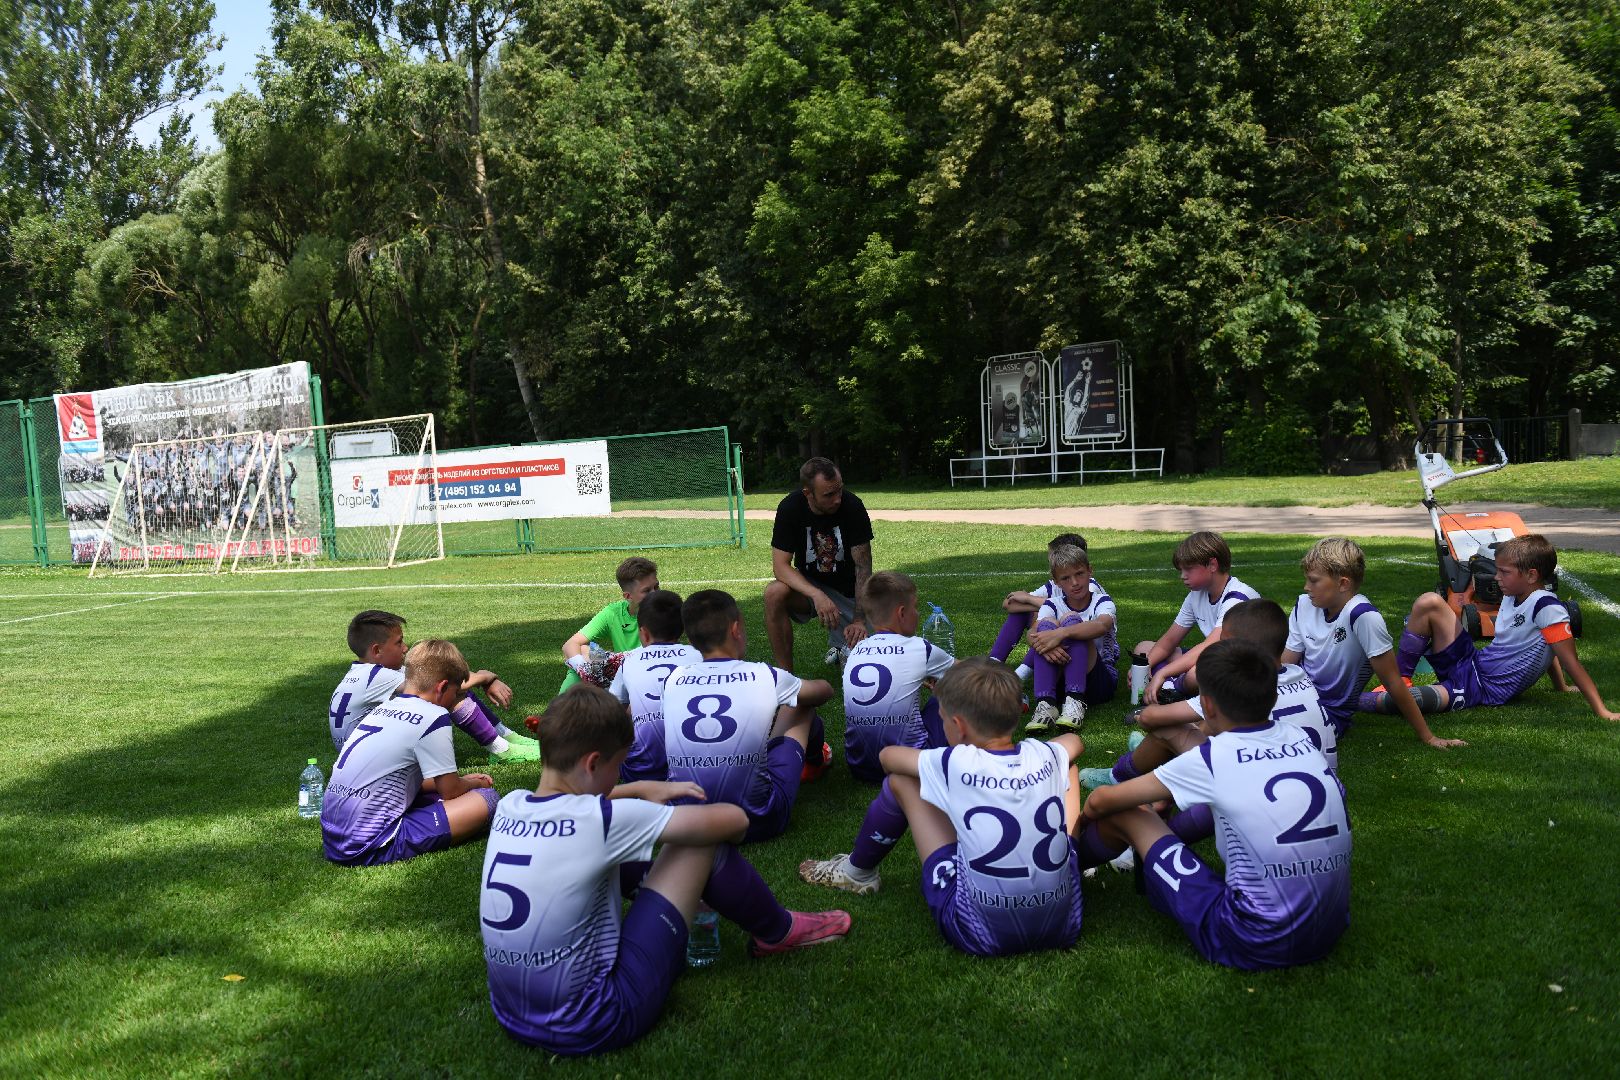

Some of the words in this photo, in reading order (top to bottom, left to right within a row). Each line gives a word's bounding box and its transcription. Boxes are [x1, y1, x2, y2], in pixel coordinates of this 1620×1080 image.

[994, 362, 1021, 373] CLASSIC
[155, 389, 177, 407] ФК
[443, 468, 471, 479] ИЗДЕЛИЙ
[471, 469, 480, 477] ИЗ
[480, 465, 514, 475] ОРГСТЕКЛА
[521, 463, 560, 473] ПЛАСТИКОВ
[444, 486, 468, 498] (495)
[469, 484, 486, 495] 152
[488, 483, 501, 494] 04
[504, 482, 517, 493] 94
[477, 498, 536, 508] www.orgplex.com
[640, 648, 687, 661] ДУКАС
[675, 671, 756, 686] ОВСЕПЯН
[850, 662, 893, 706] 9
[681, 694, 738, 743] 8
[337, 723, 384, 769] 7
[963, 795, 1070, 878] 28
[1153, 842, 1200, 892] 21
[482, 851, 532, 931] 5
